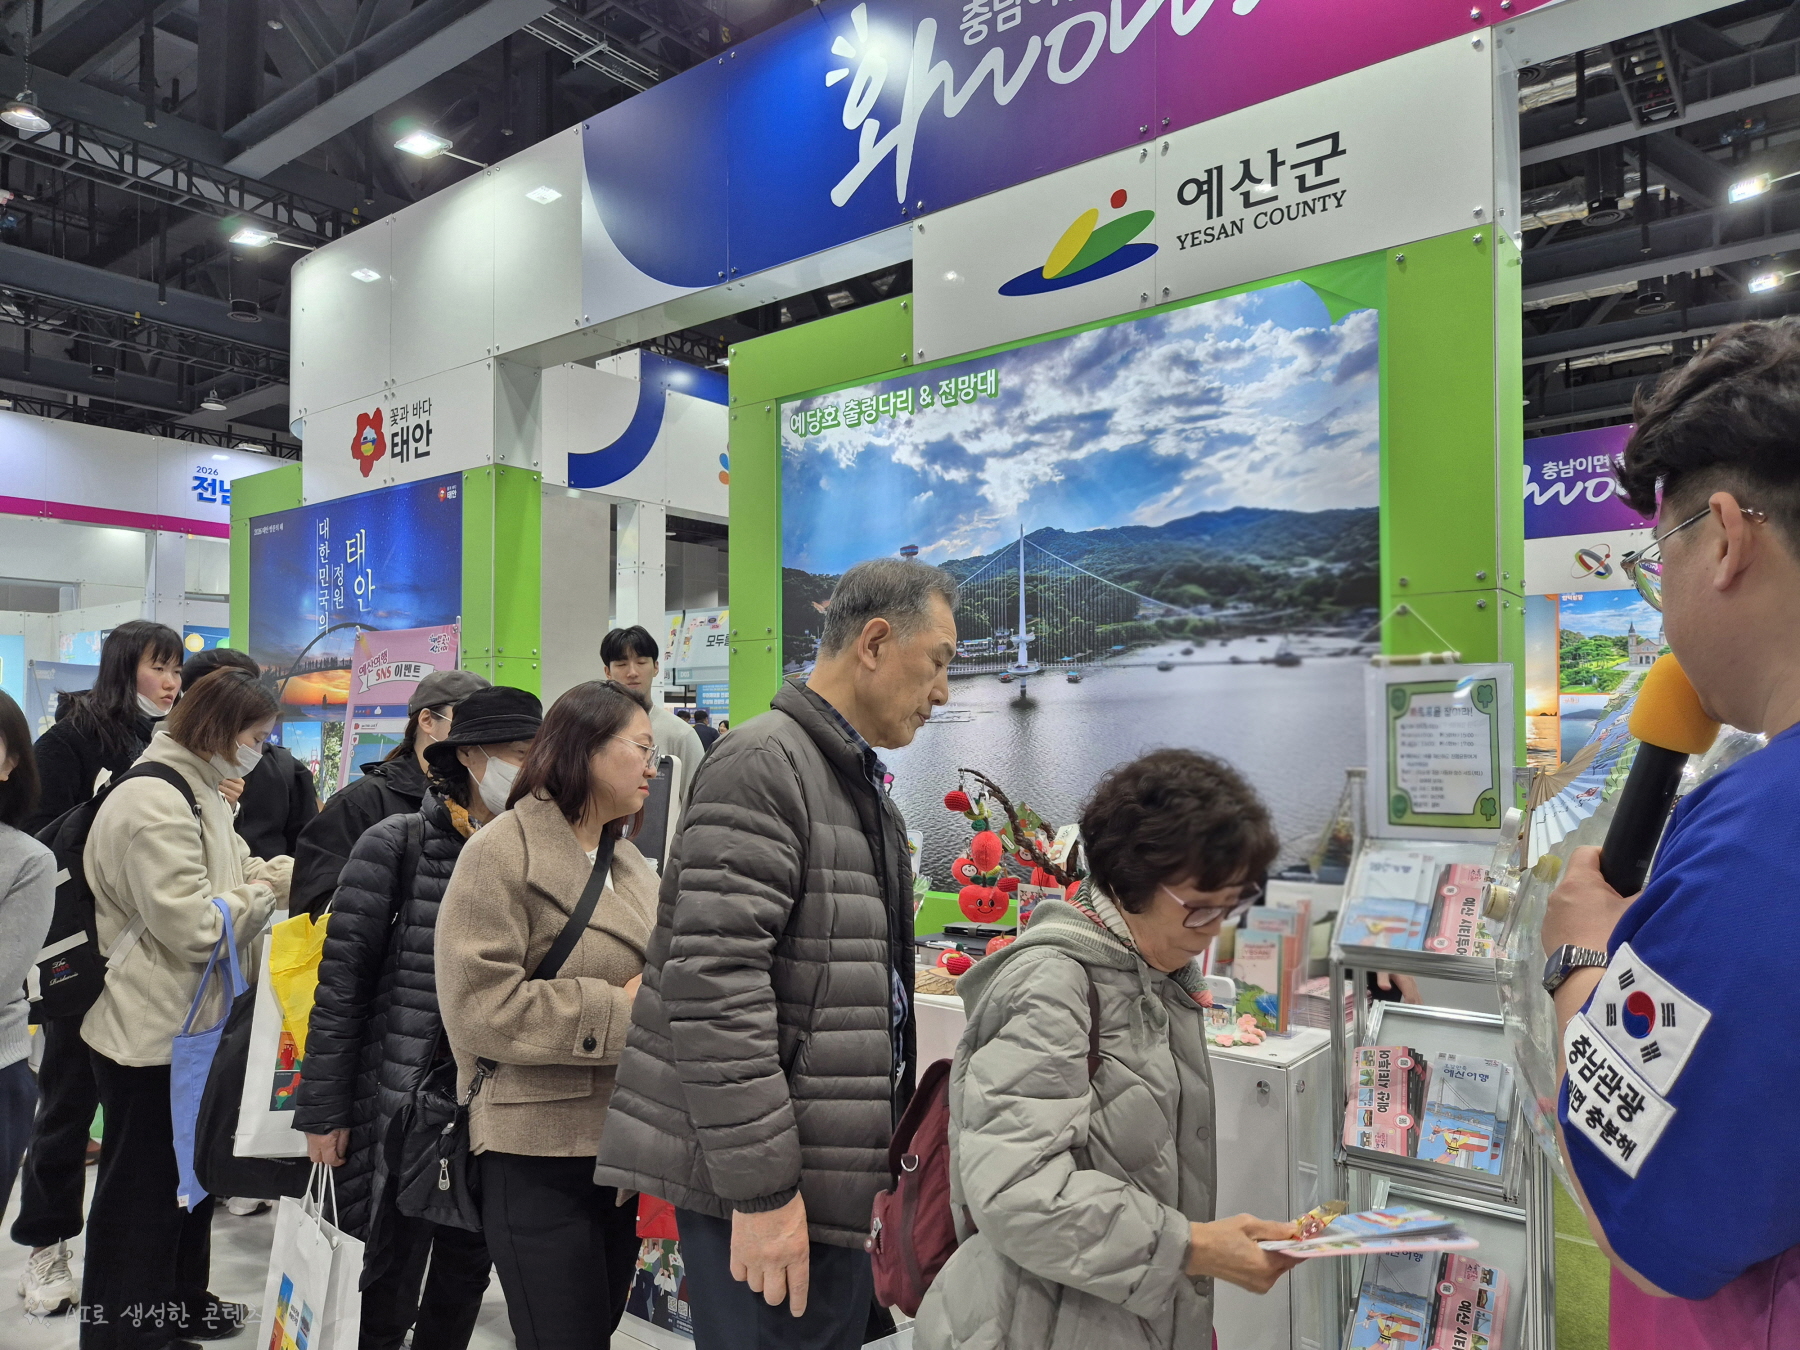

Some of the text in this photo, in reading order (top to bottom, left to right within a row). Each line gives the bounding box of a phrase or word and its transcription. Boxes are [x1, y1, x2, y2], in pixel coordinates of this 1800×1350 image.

[1177, 131, 1347, 221] 예산군
[1176, 189, 1347, 251] YESAN COUNTY
[390, 397, 433, 427] 꽃과 바다
[789, 368, 1000, 437] 예당호 출렁다리 & 전망대
[390, 419, 433, 463] 태안
[196, 465, 219, 476] 2026
[1542, 455, 1611, 480] 충남이면
[319, 517, 330, 634] 대한민국의
[333, 563, 344, 609] 정원
[346, 529, 376, 612] 태안
[358, 649, 389, 676] 예산여행
[375, 664, 421, 682] SNS 이벤트
[1461, 897, 1476, 917] 예산
[1377, 1050, 1391, 1113] 예산 시티투어
[1568, 1033, 1645, 1123] 충남관광
[1585, 1105, 1638, 1162] 충분해
[1456, 1300, 1471, 1325] 예산
